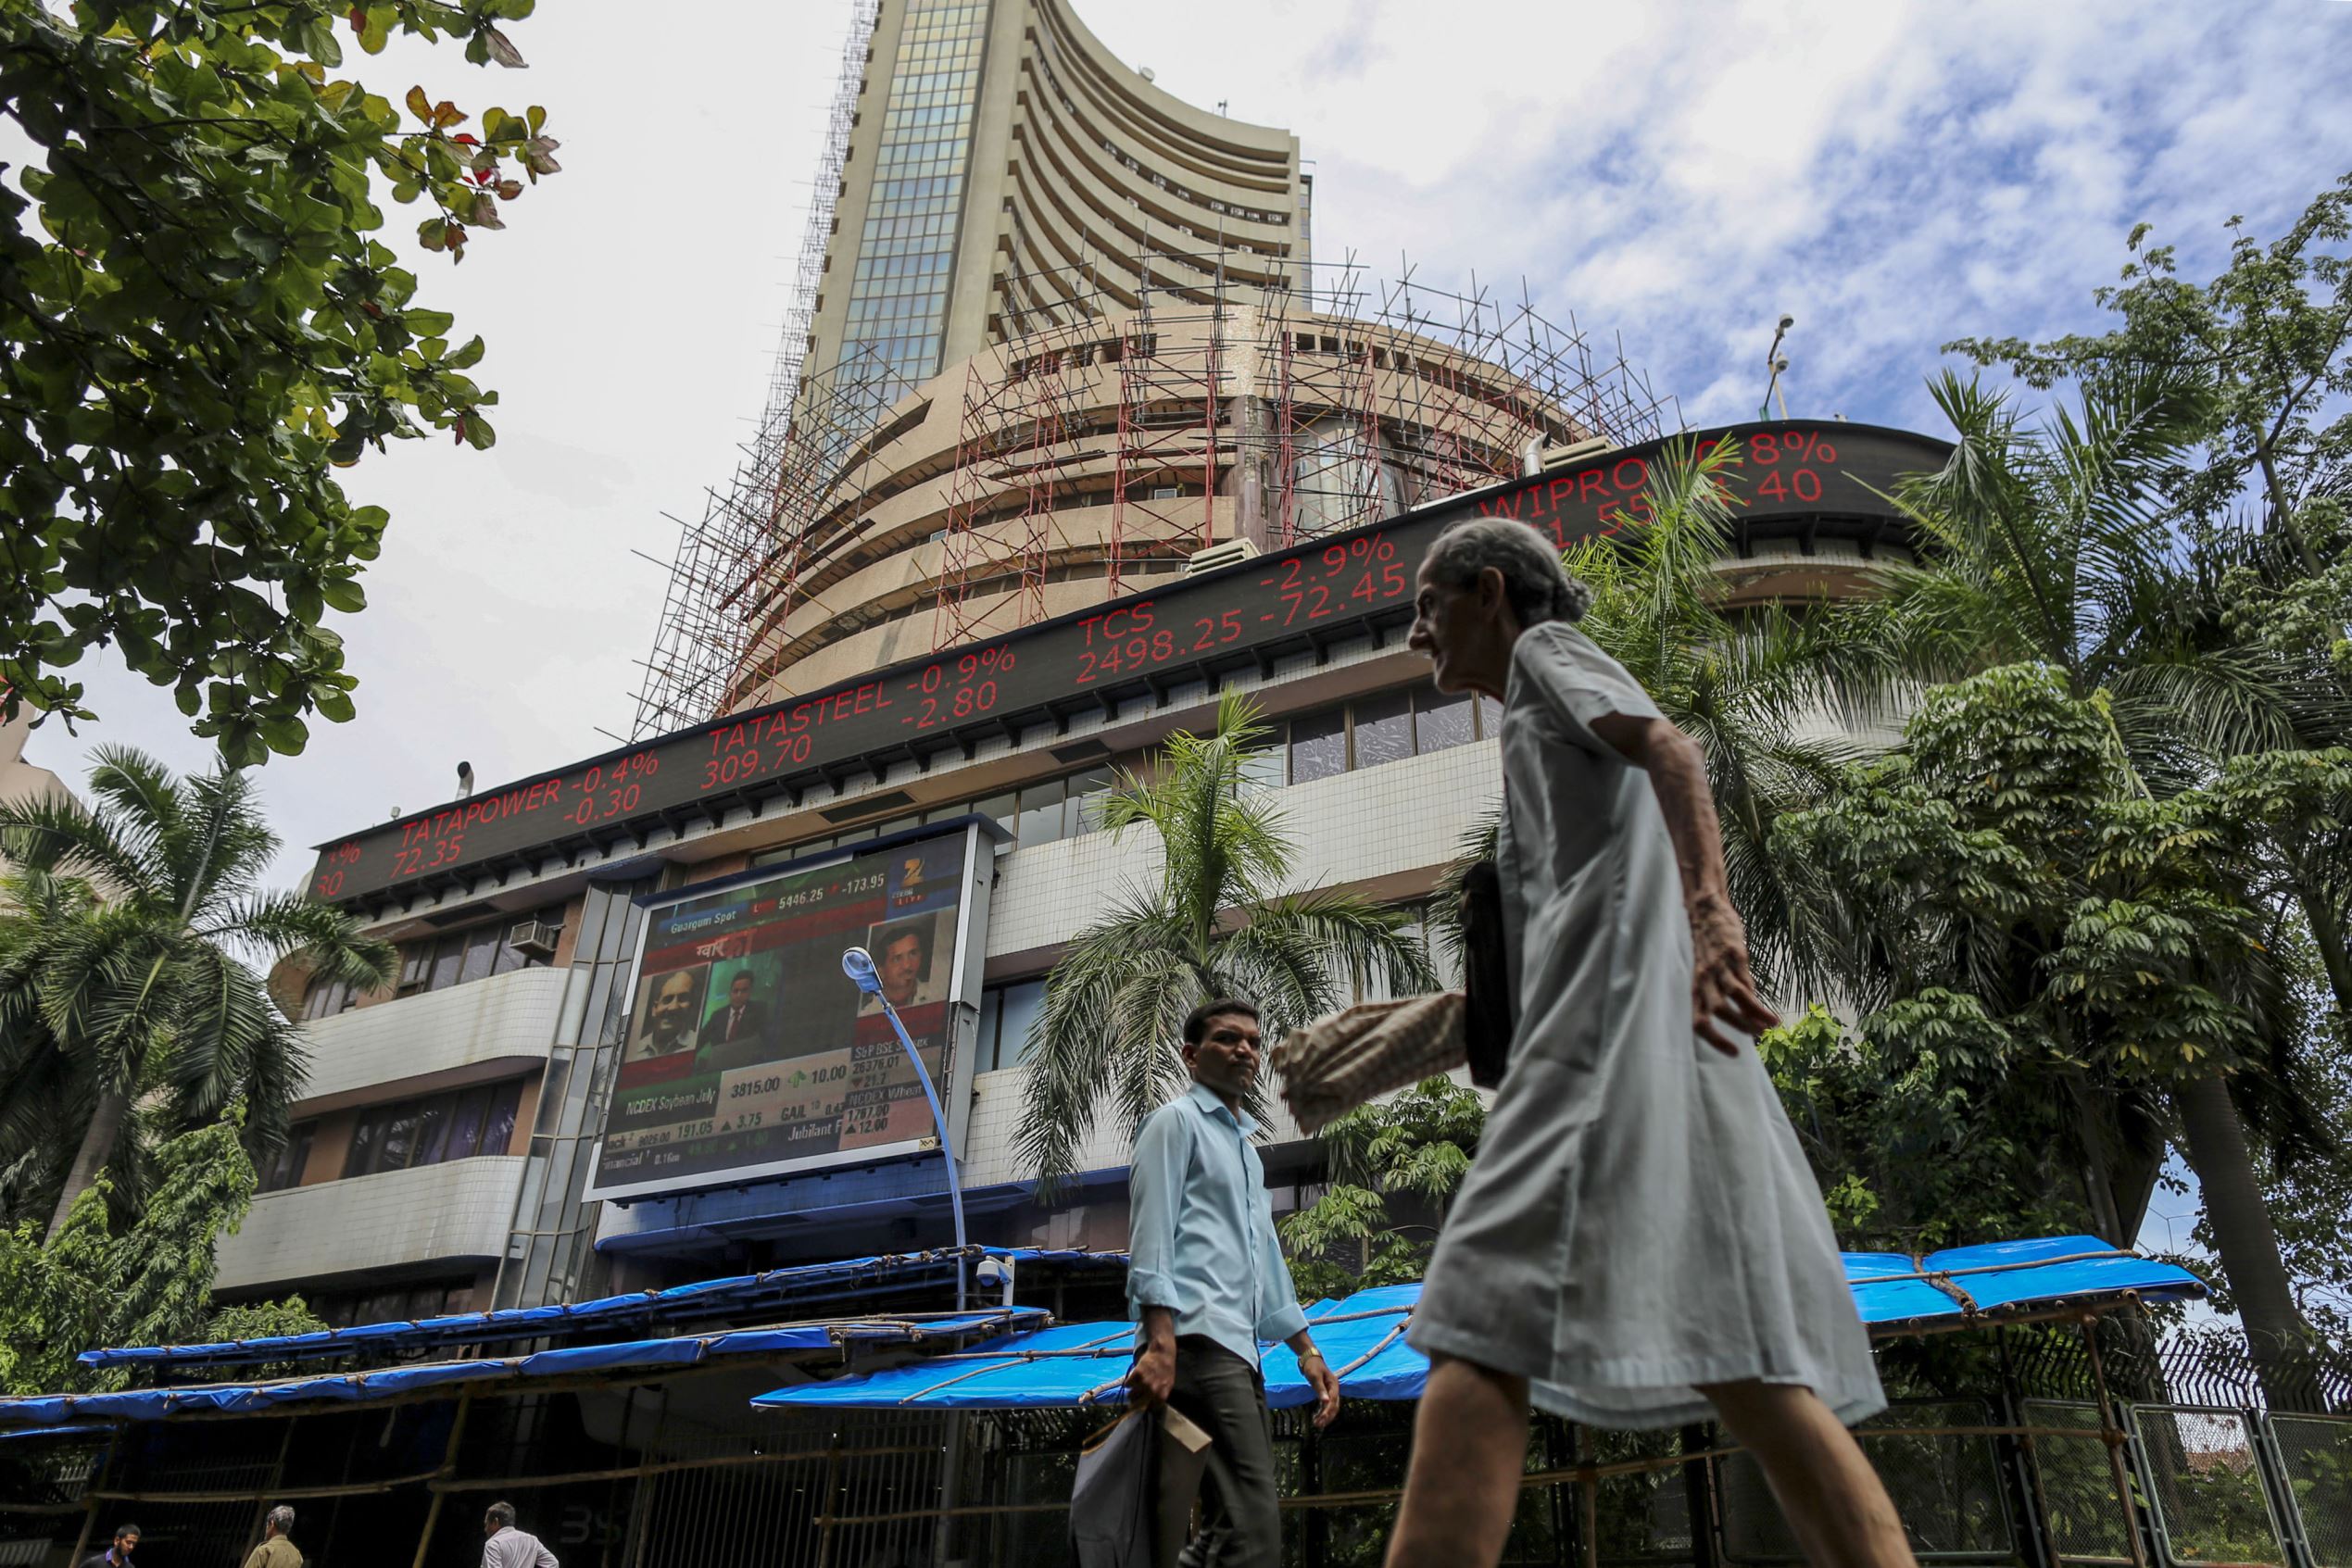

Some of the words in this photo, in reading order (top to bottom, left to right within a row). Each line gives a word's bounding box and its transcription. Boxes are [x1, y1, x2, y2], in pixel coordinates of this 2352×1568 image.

[1479, 458, 1648, 521] WIPRO
[1075, 608, 1242, 685] 2498.25
[1260, 563, 1406, 627] -72.45
[1077, 601, 1155, 648] TCS
[1260, 532, 1396, 593] -2.9%
[699, 735, 811, 792] 309.70
[900, 680, 997, 731] -2.80
[709, 684, 893, 757] TATASTEEL
[907, 643, 1016, 695] -0.9%
[390, 834, 465, 879] 72.35
[563, 784, 640, 826] -0.30
[402, 779, 561, 849] TATAPOWER
[571, 749, 660, 795] -0.4%
[714, 910, 738, 925] Spot
[778, 888, 824, 910] 5446.25
[841, 873, 885, 896] -173.95
[625, 1098, 658, 1116] NCDEX
[659, 1094, 695, 1111] Soybean
[731, 1077, 780, 1098] 3815.00
[811, 1065, 848, 1085] 10.00
[677, 1119, 713, 1139] 191.05
[736, 1111, 762, 1129] 3.75
[780, 1104, 808, 1123] GAIL
[787, 1123, 832, 1142] Jubilant
